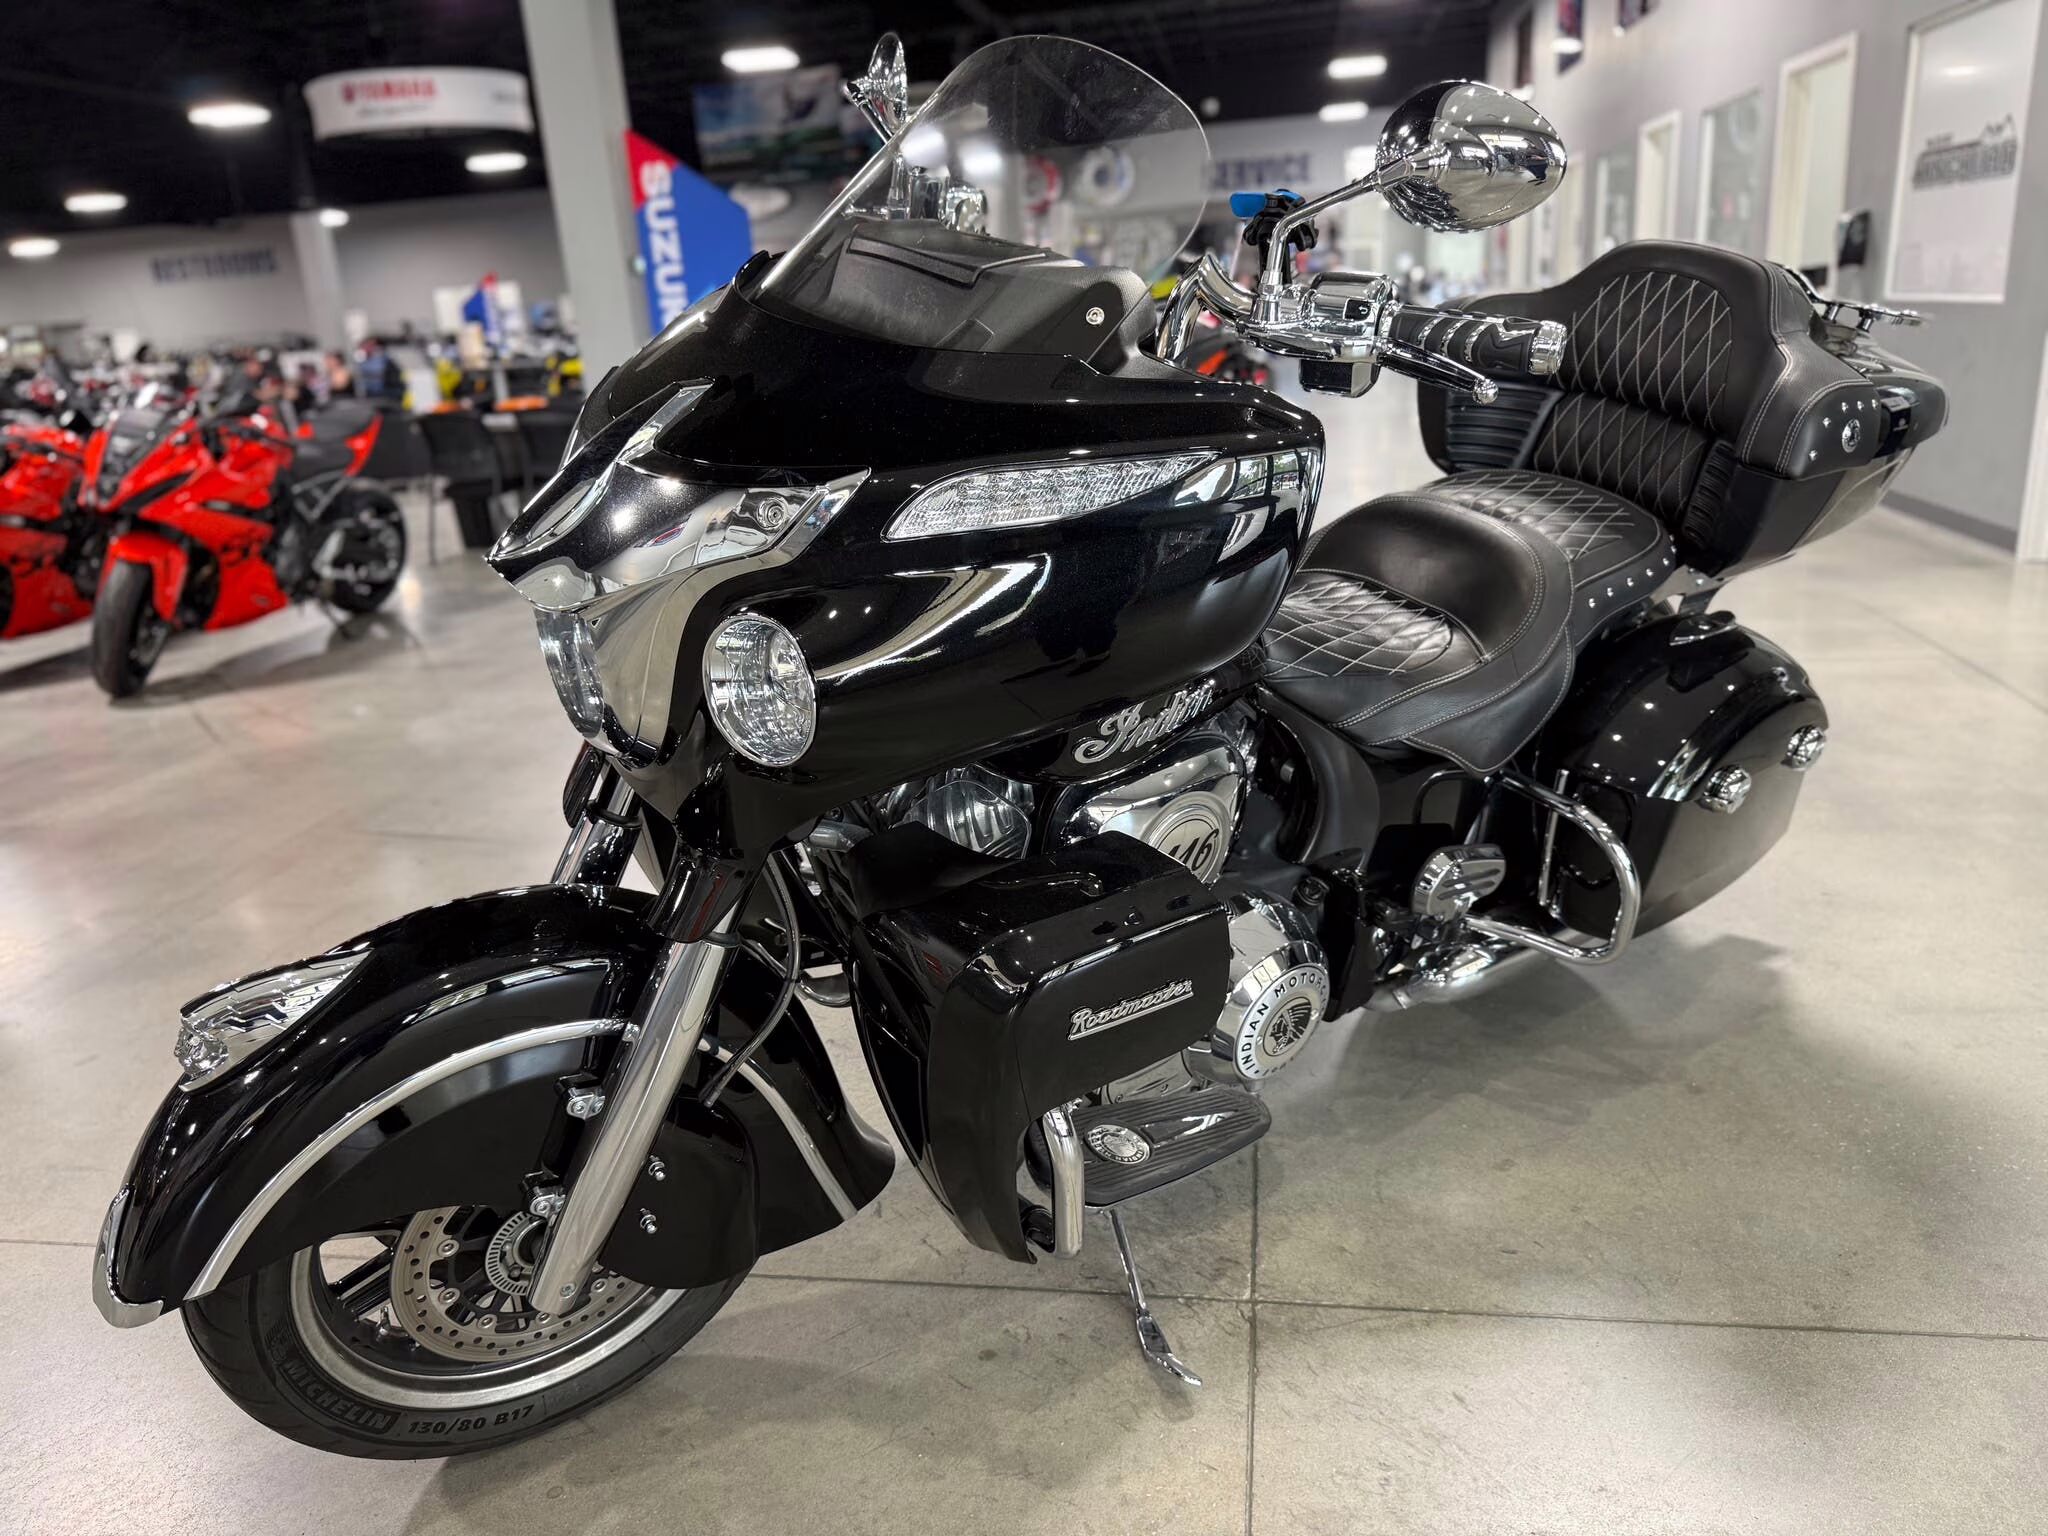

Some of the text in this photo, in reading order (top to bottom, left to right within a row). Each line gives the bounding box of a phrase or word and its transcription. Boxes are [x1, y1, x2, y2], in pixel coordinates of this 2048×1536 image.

[639, 161, 689, 328] SUZUK
[1074, 680, 1215, 764] Indian
[1069, 979, 1193, 1036] Roadmaster
[1241, 1003, 1270, 1071] INDIAN
[284, 1360, 393, 1430] MICHELIN
[408, 1404, 535, 1436] 130/80 B17
